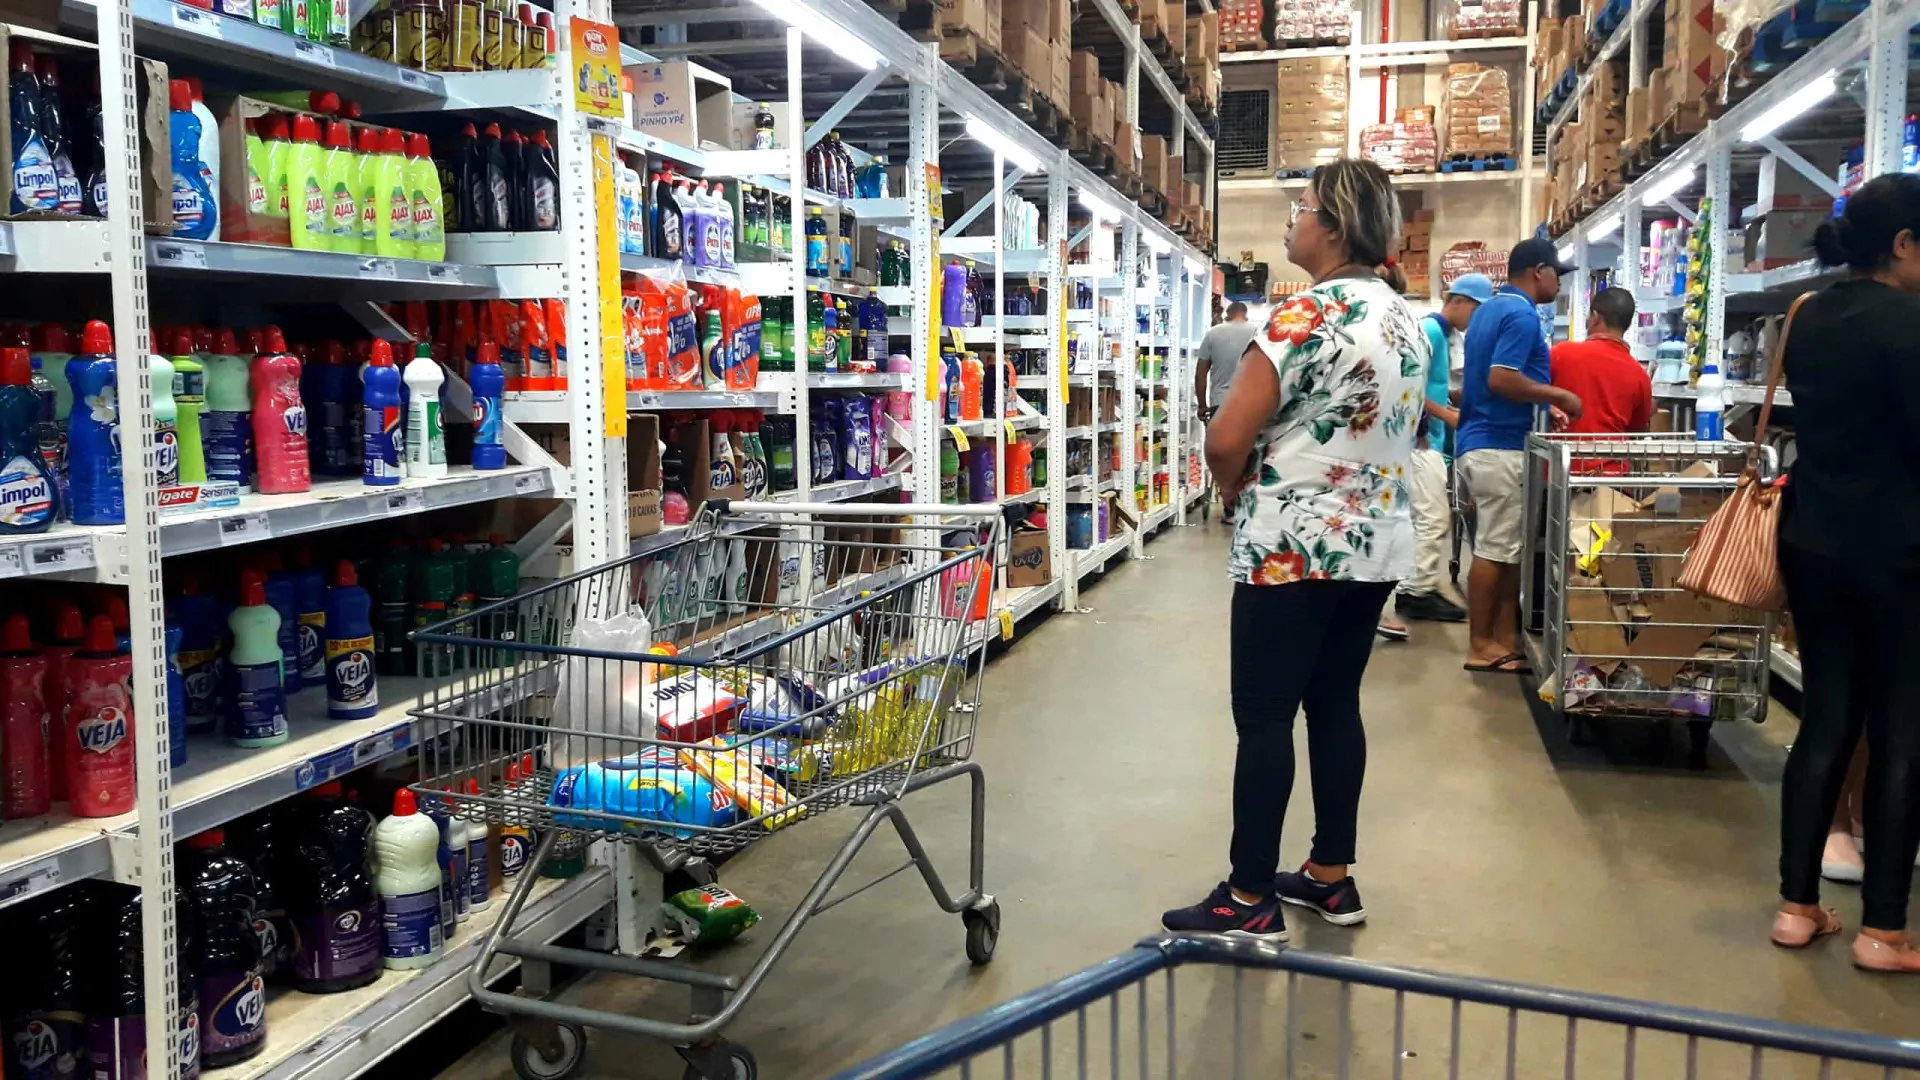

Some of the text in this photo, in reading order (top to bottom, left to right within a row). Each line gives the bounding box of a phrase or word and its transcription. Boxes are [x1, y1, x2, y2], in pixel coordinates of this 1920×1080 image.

[640, 115, 667, 126] PINHO
[17, 171, 54, 189] Limpol
[306, 199, 325, 214] AJAX
[334, 203, 354, 218] AJAX
[391, 206, 409, 222] AJAX
[158, 489, 193, 506] lgate
[338, 661, 369, 683] VEJA
[343, 683, 365, 696] Gold
[79, 718, 125, 748] VEJA
